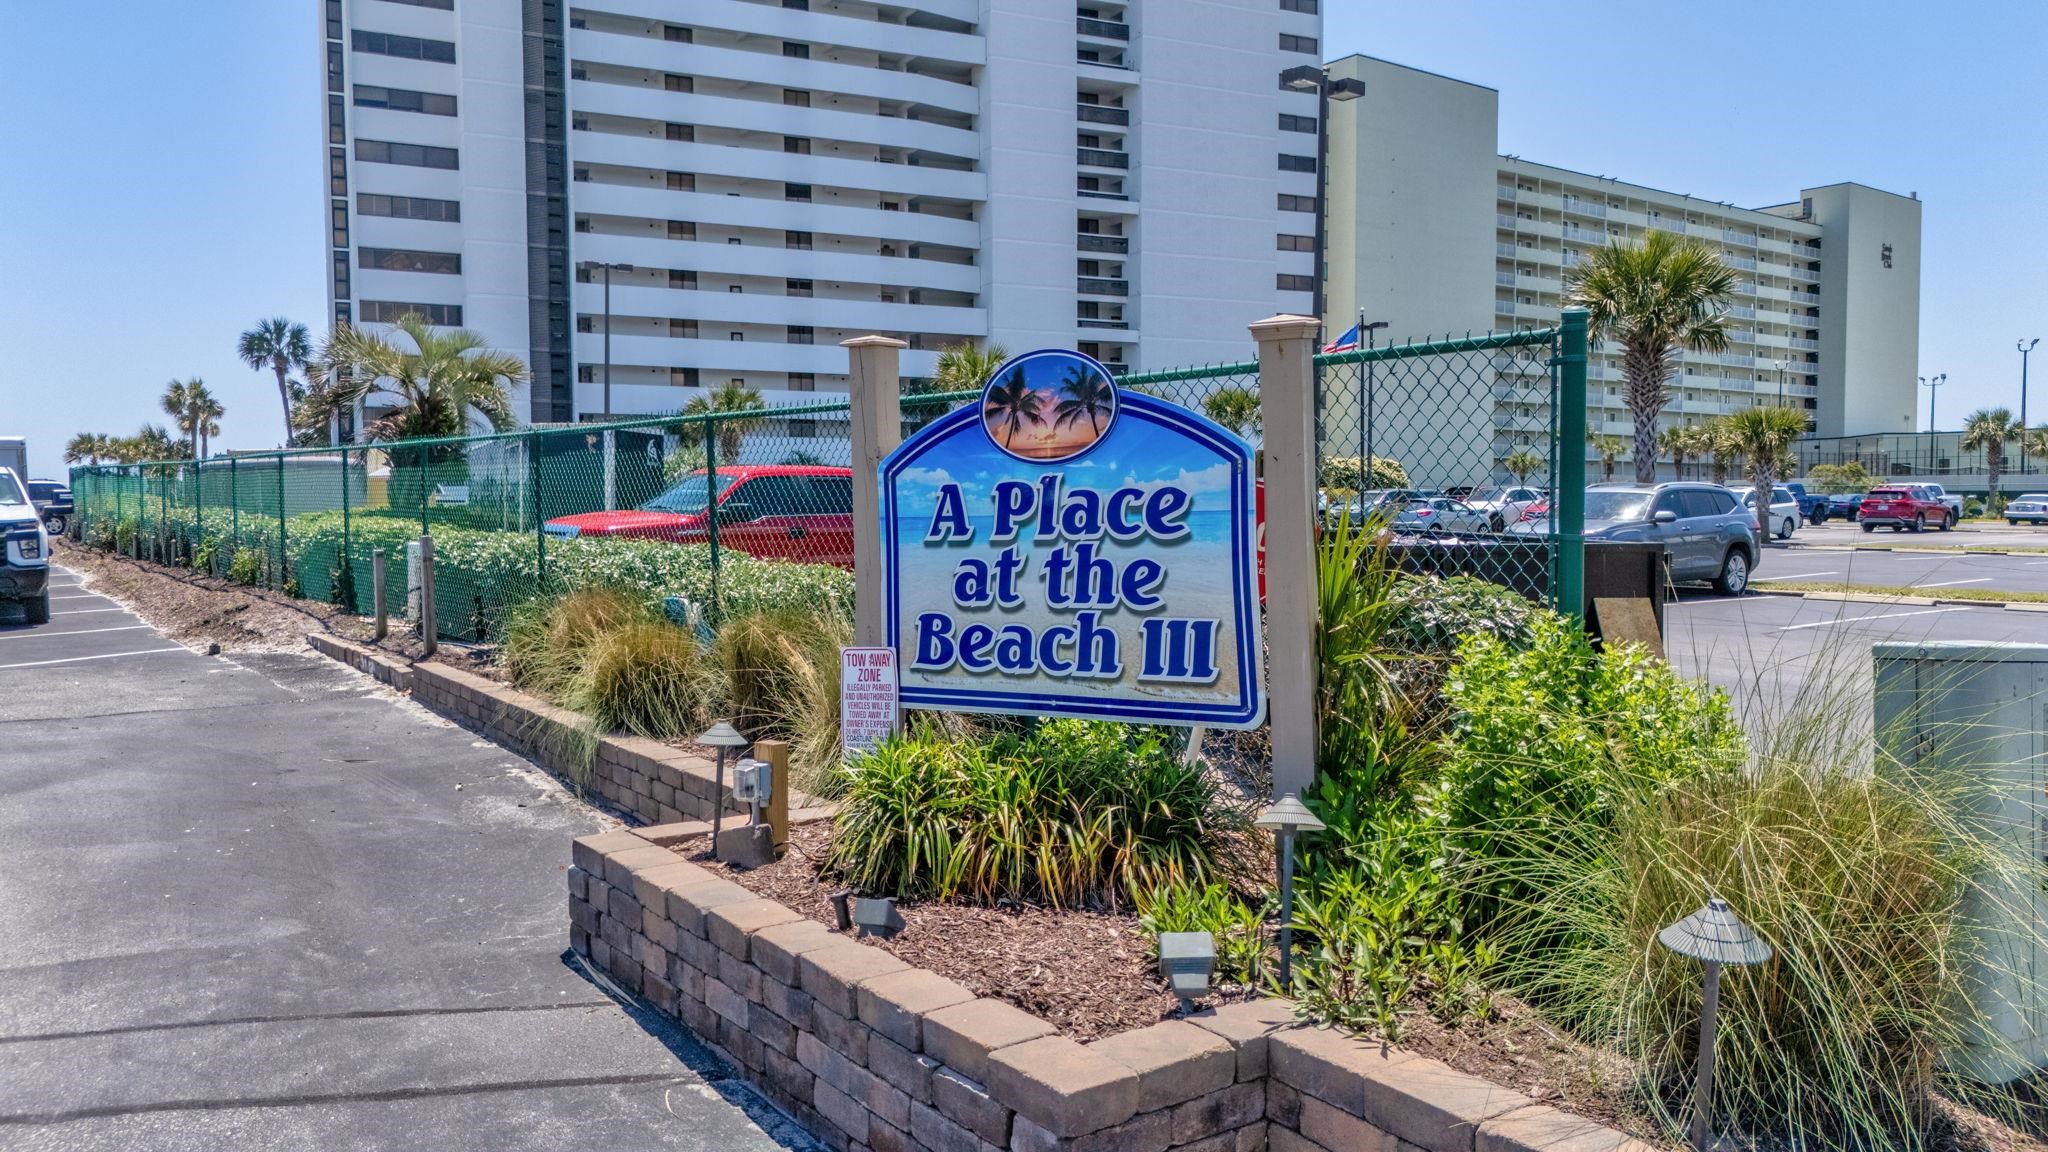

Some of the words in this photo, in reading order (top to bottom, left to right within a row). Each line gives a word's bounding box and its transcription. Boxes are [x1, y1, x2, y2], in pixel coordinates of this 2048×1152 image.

[924, 482, 973, 542] A
[990, 472, 1193, 542] Place
[952, 546, 1027, 608] at
[1040, 541, 1168, 612] the
[910, 610, 1123, 679] Beach
[1138, 618, 1222, 683] III
[846, 653, 866, 667] TOW
[869, 653, 891, 667] AWAY
[857, 668, 881, 682] ZONE
[847, 683, 871, 691] ILLEGALLY
[872, 683, 892, 691] PARKED
[845, 692, 856, 700] AND
[856, 692, 894, 701] UNAUTHORIZED
[872, 702, 883, 710] WILL
[885, 702, 891, 710] BE
[849, 710, 867, 718] TOWED
[868, 711, 881, 719] AWAY
[884, 711, 890, 719] AT
